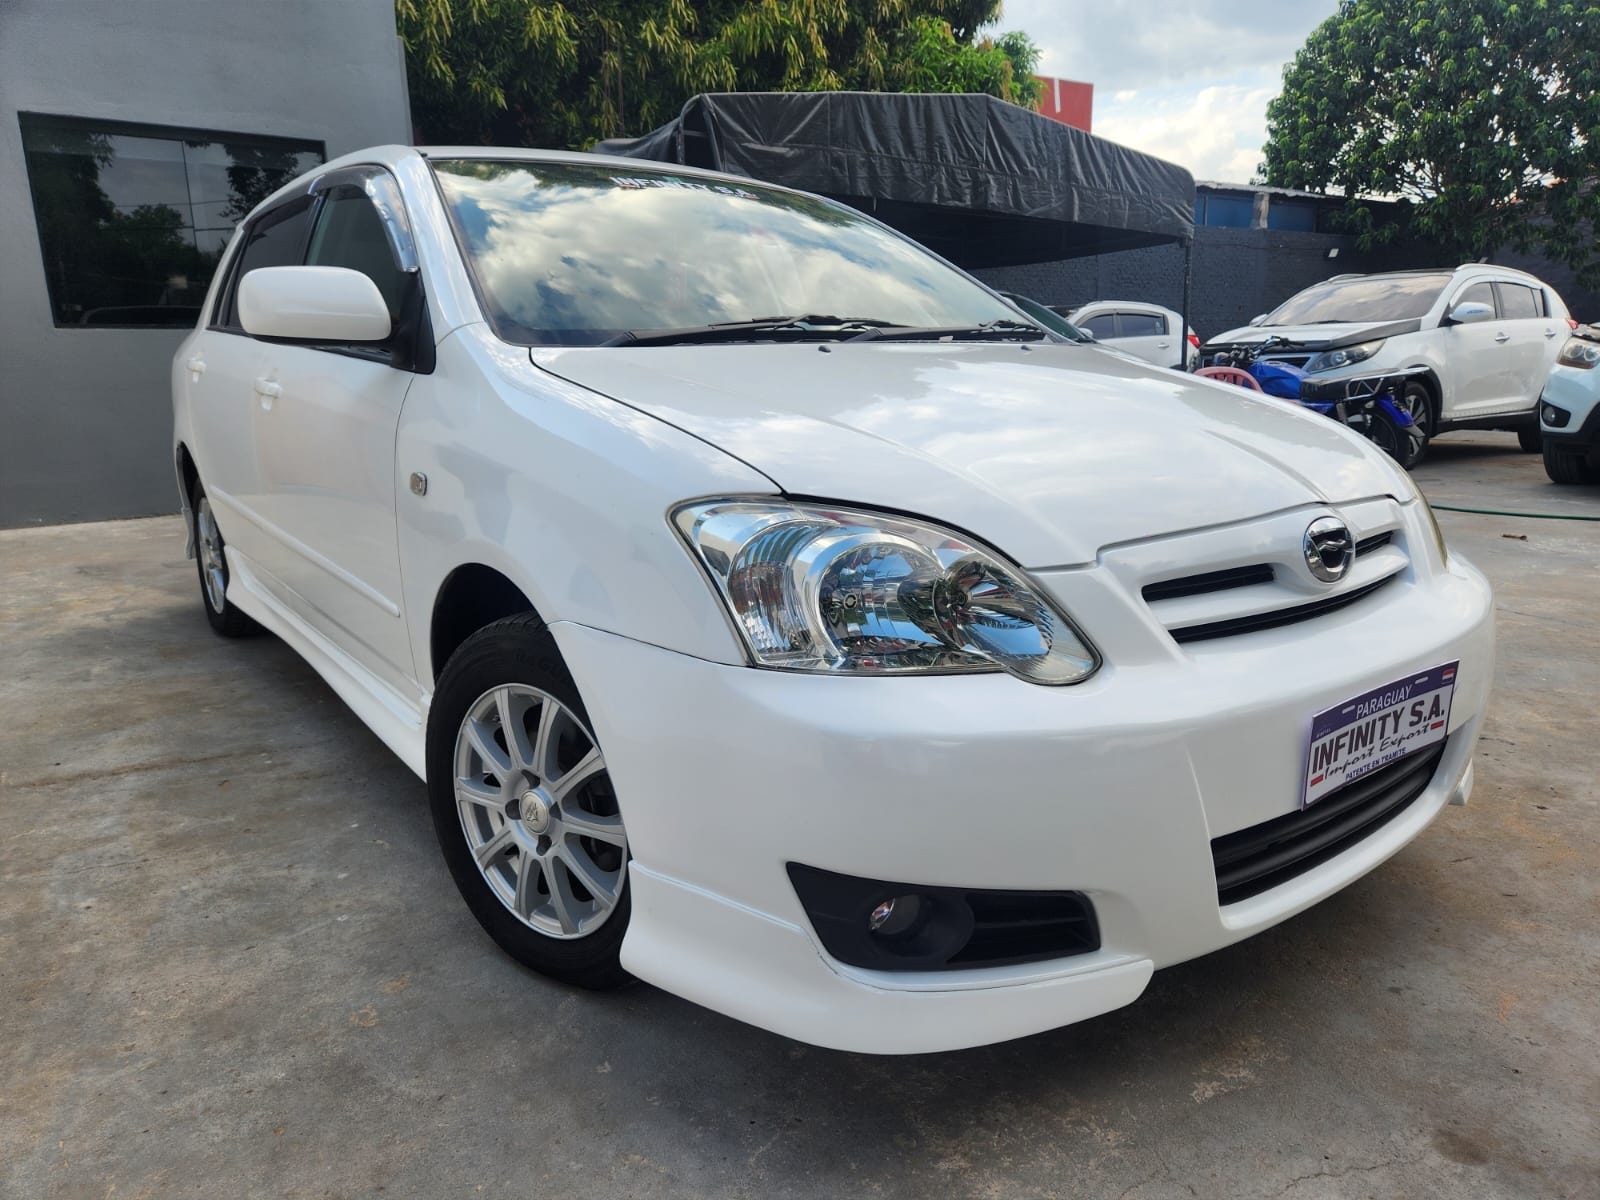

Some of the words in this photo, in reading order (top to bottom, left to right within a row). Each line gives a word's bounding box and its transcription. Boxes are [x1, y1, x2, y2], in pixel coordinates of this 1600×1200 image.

[1355, 684, 1412, 719] PARAGUAY
[1312, 706, 1405, 775] INFINITY
[1409, 694, 1445, 728] S.A.
[1324, 746, 1375, 779] Import
[1379, 723, 1430, 752] Export
[1346, 763, 1371, 780] PATENTE
[1371, 758, 1380, 769] EN
[1381, 747, 1406, 762] TRAMITE
